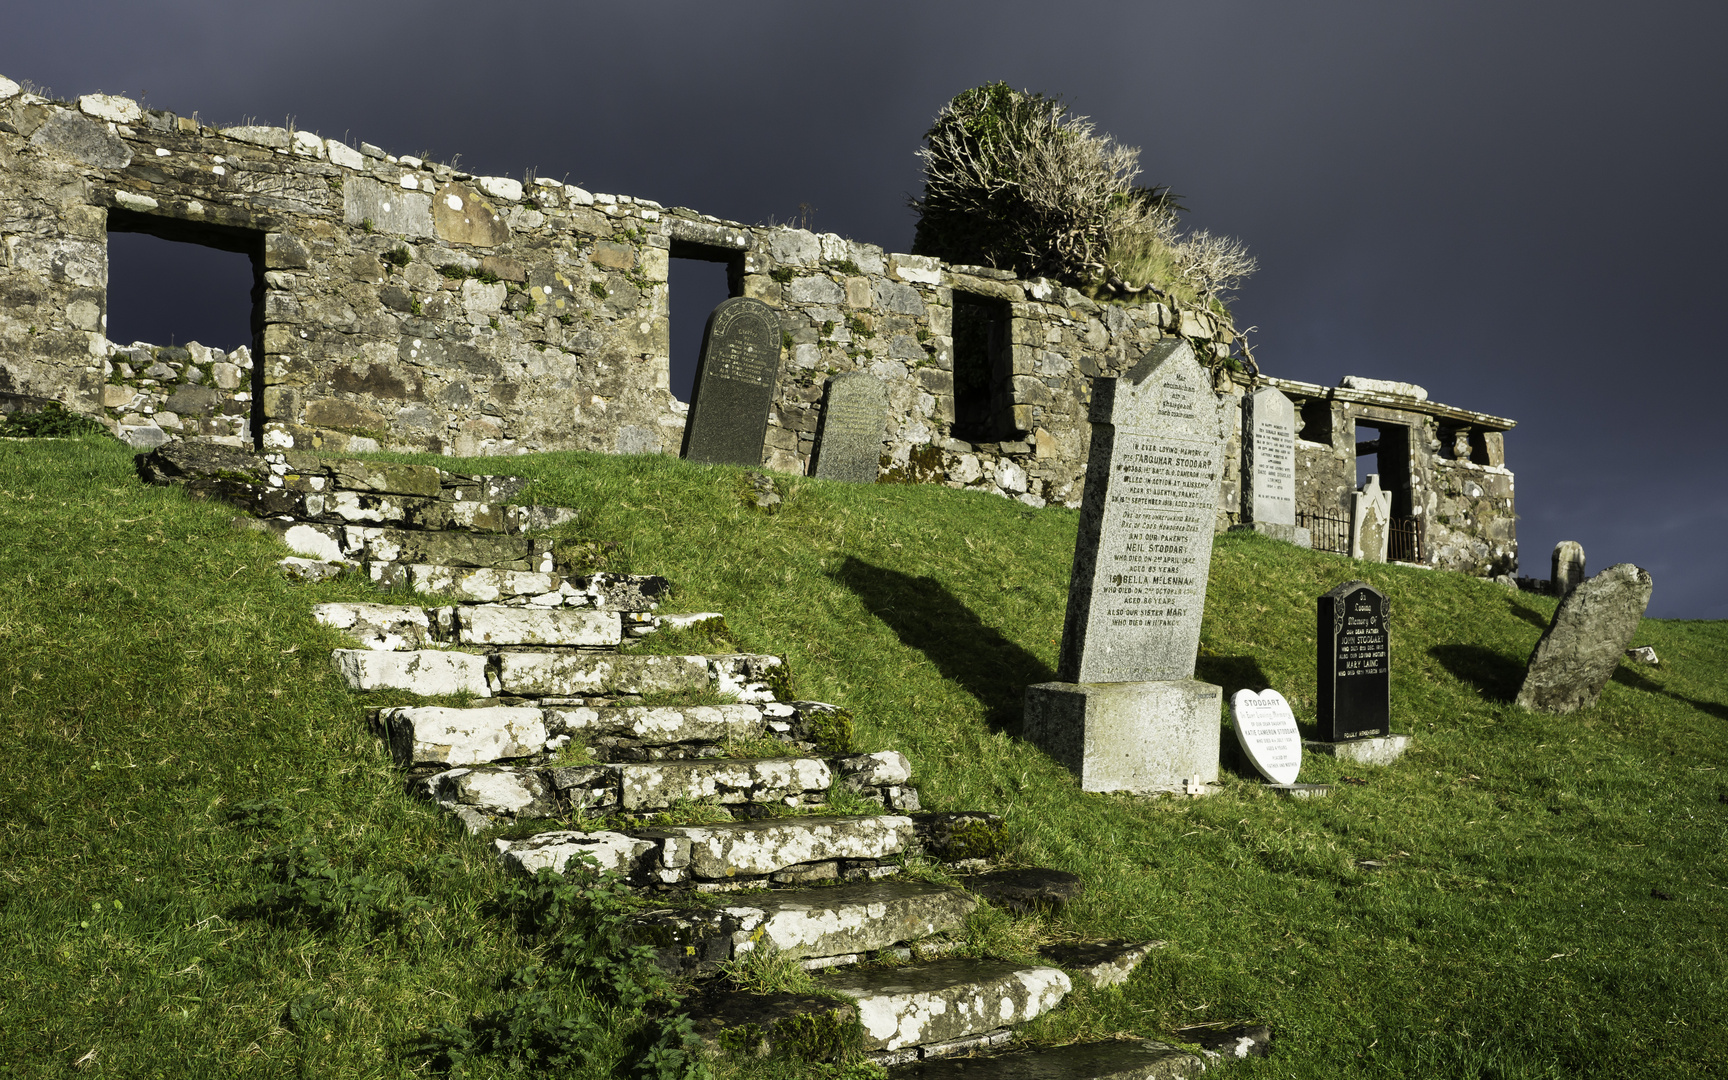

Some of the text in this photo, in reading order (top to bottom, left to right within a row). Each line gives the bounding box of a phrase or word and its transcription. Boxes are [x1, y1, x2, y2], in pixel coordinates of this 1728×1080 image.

[1135, 454, 1172, 466] FARQUHAR
[1132, 497, 1162, 505] SEPTEMBER
[1126, 543, 1187, 553] NEIL STODDART
[1357, 635, 1384, 644] STODDART
[1363, 659, 1378, 668] LAING
